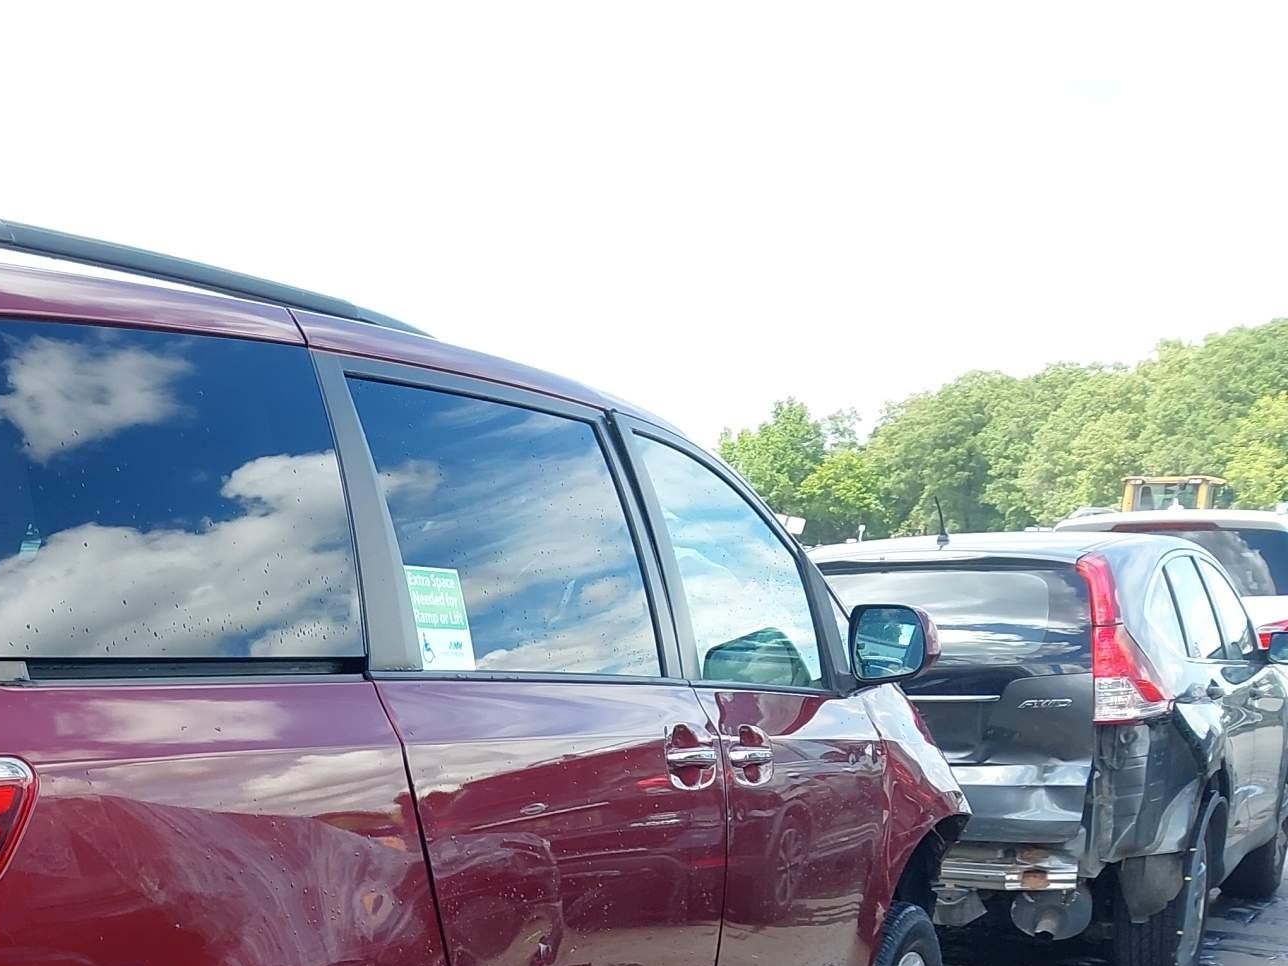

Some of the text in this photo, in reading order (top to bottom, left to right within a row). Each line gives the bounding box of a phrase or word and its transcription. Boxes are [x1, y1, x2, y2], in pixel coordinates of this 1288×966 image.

[406, 571, 456, 591] Extra Space
[411, 590, 445, 606] Needed
[414, 609, 465, 626] Ramp or Lift
[1016, 698, 1073, 709] AWD
